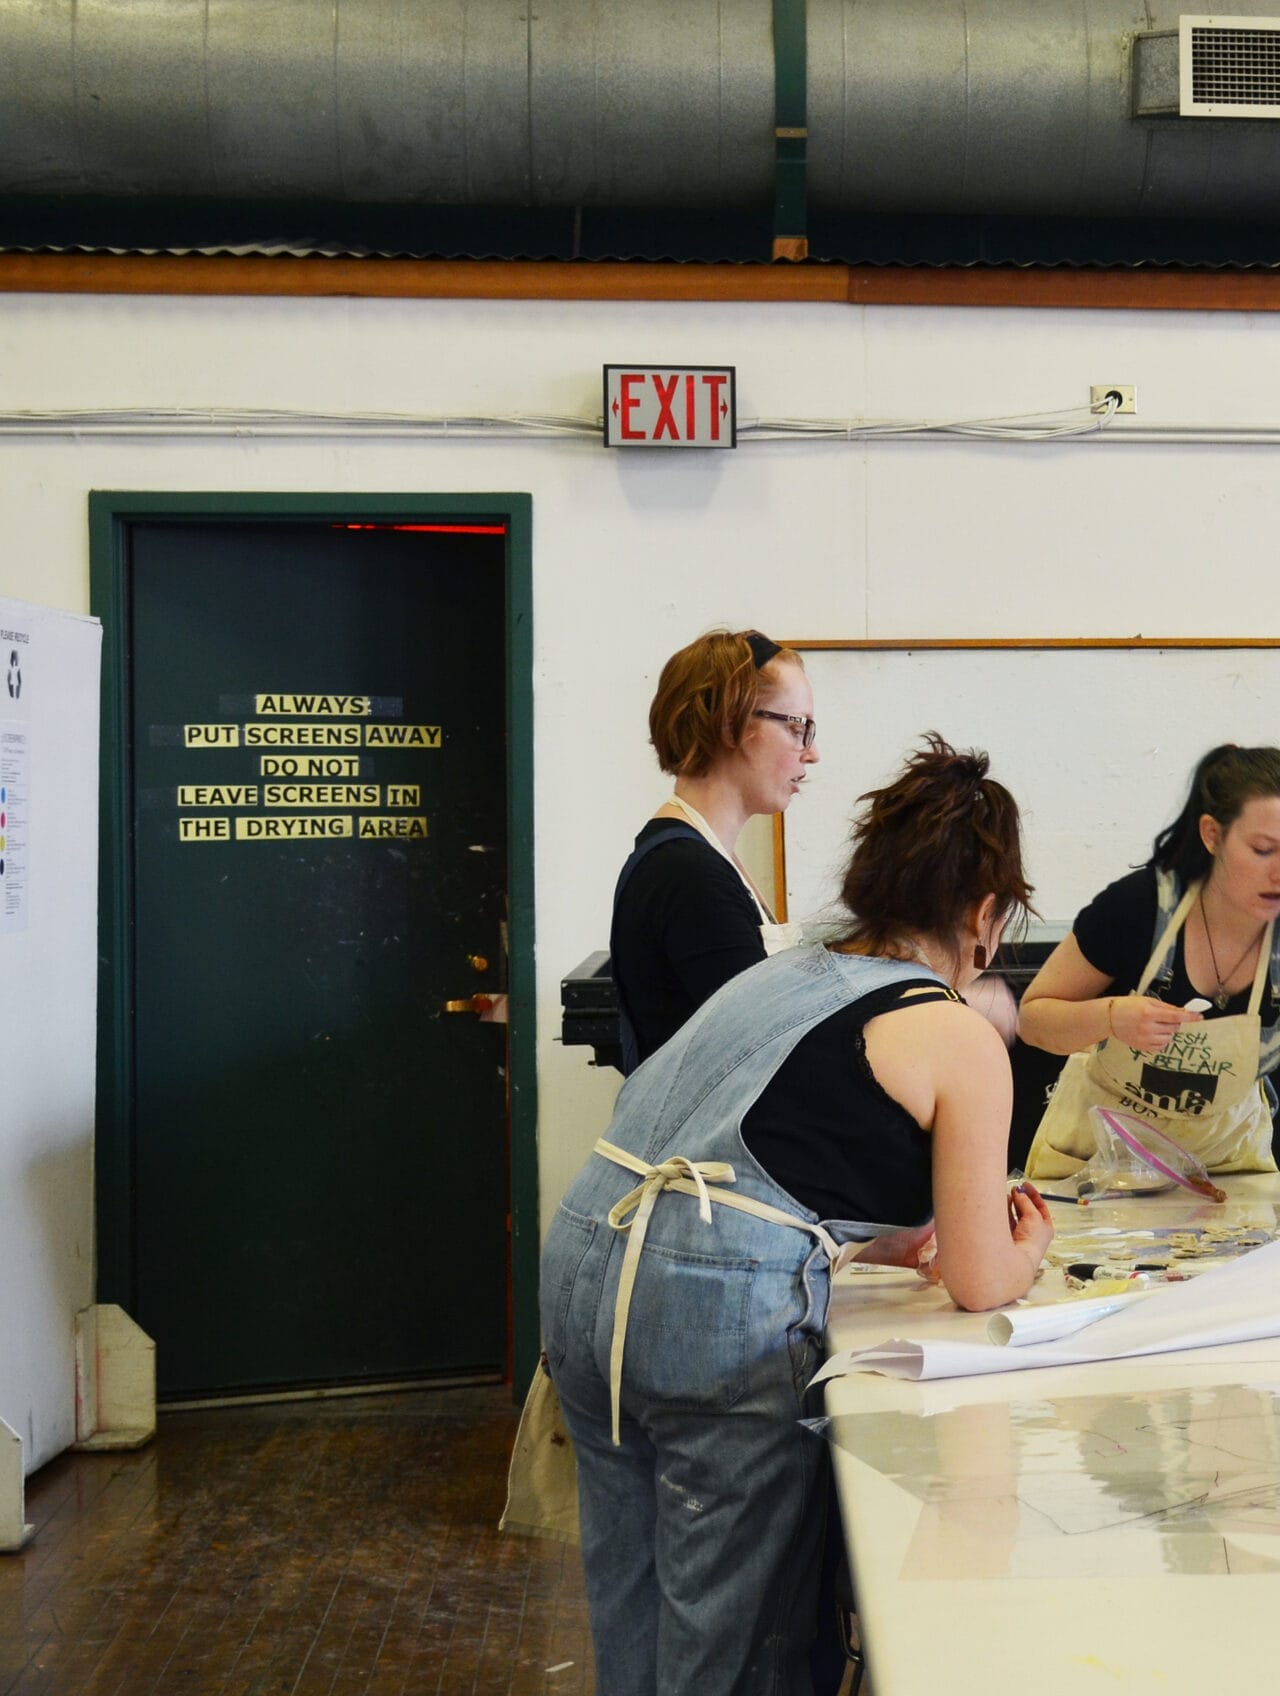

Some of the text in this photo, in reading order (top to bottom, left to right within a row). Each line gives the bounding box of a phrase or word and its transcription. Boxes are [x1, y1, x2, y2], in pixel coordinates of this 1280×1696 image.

[620, 374, 727, 440] EXIT
[187, 726, 440, 745] PUT SCREENS AWAY
[263, 758, 358, 776] DO NOT
[180, 786, 418, 806] LEAVE SCREENS IN
[181, 818, 425, 837] THE DRYING AREA
[1171, 1032, 1209, 1046] ESH
